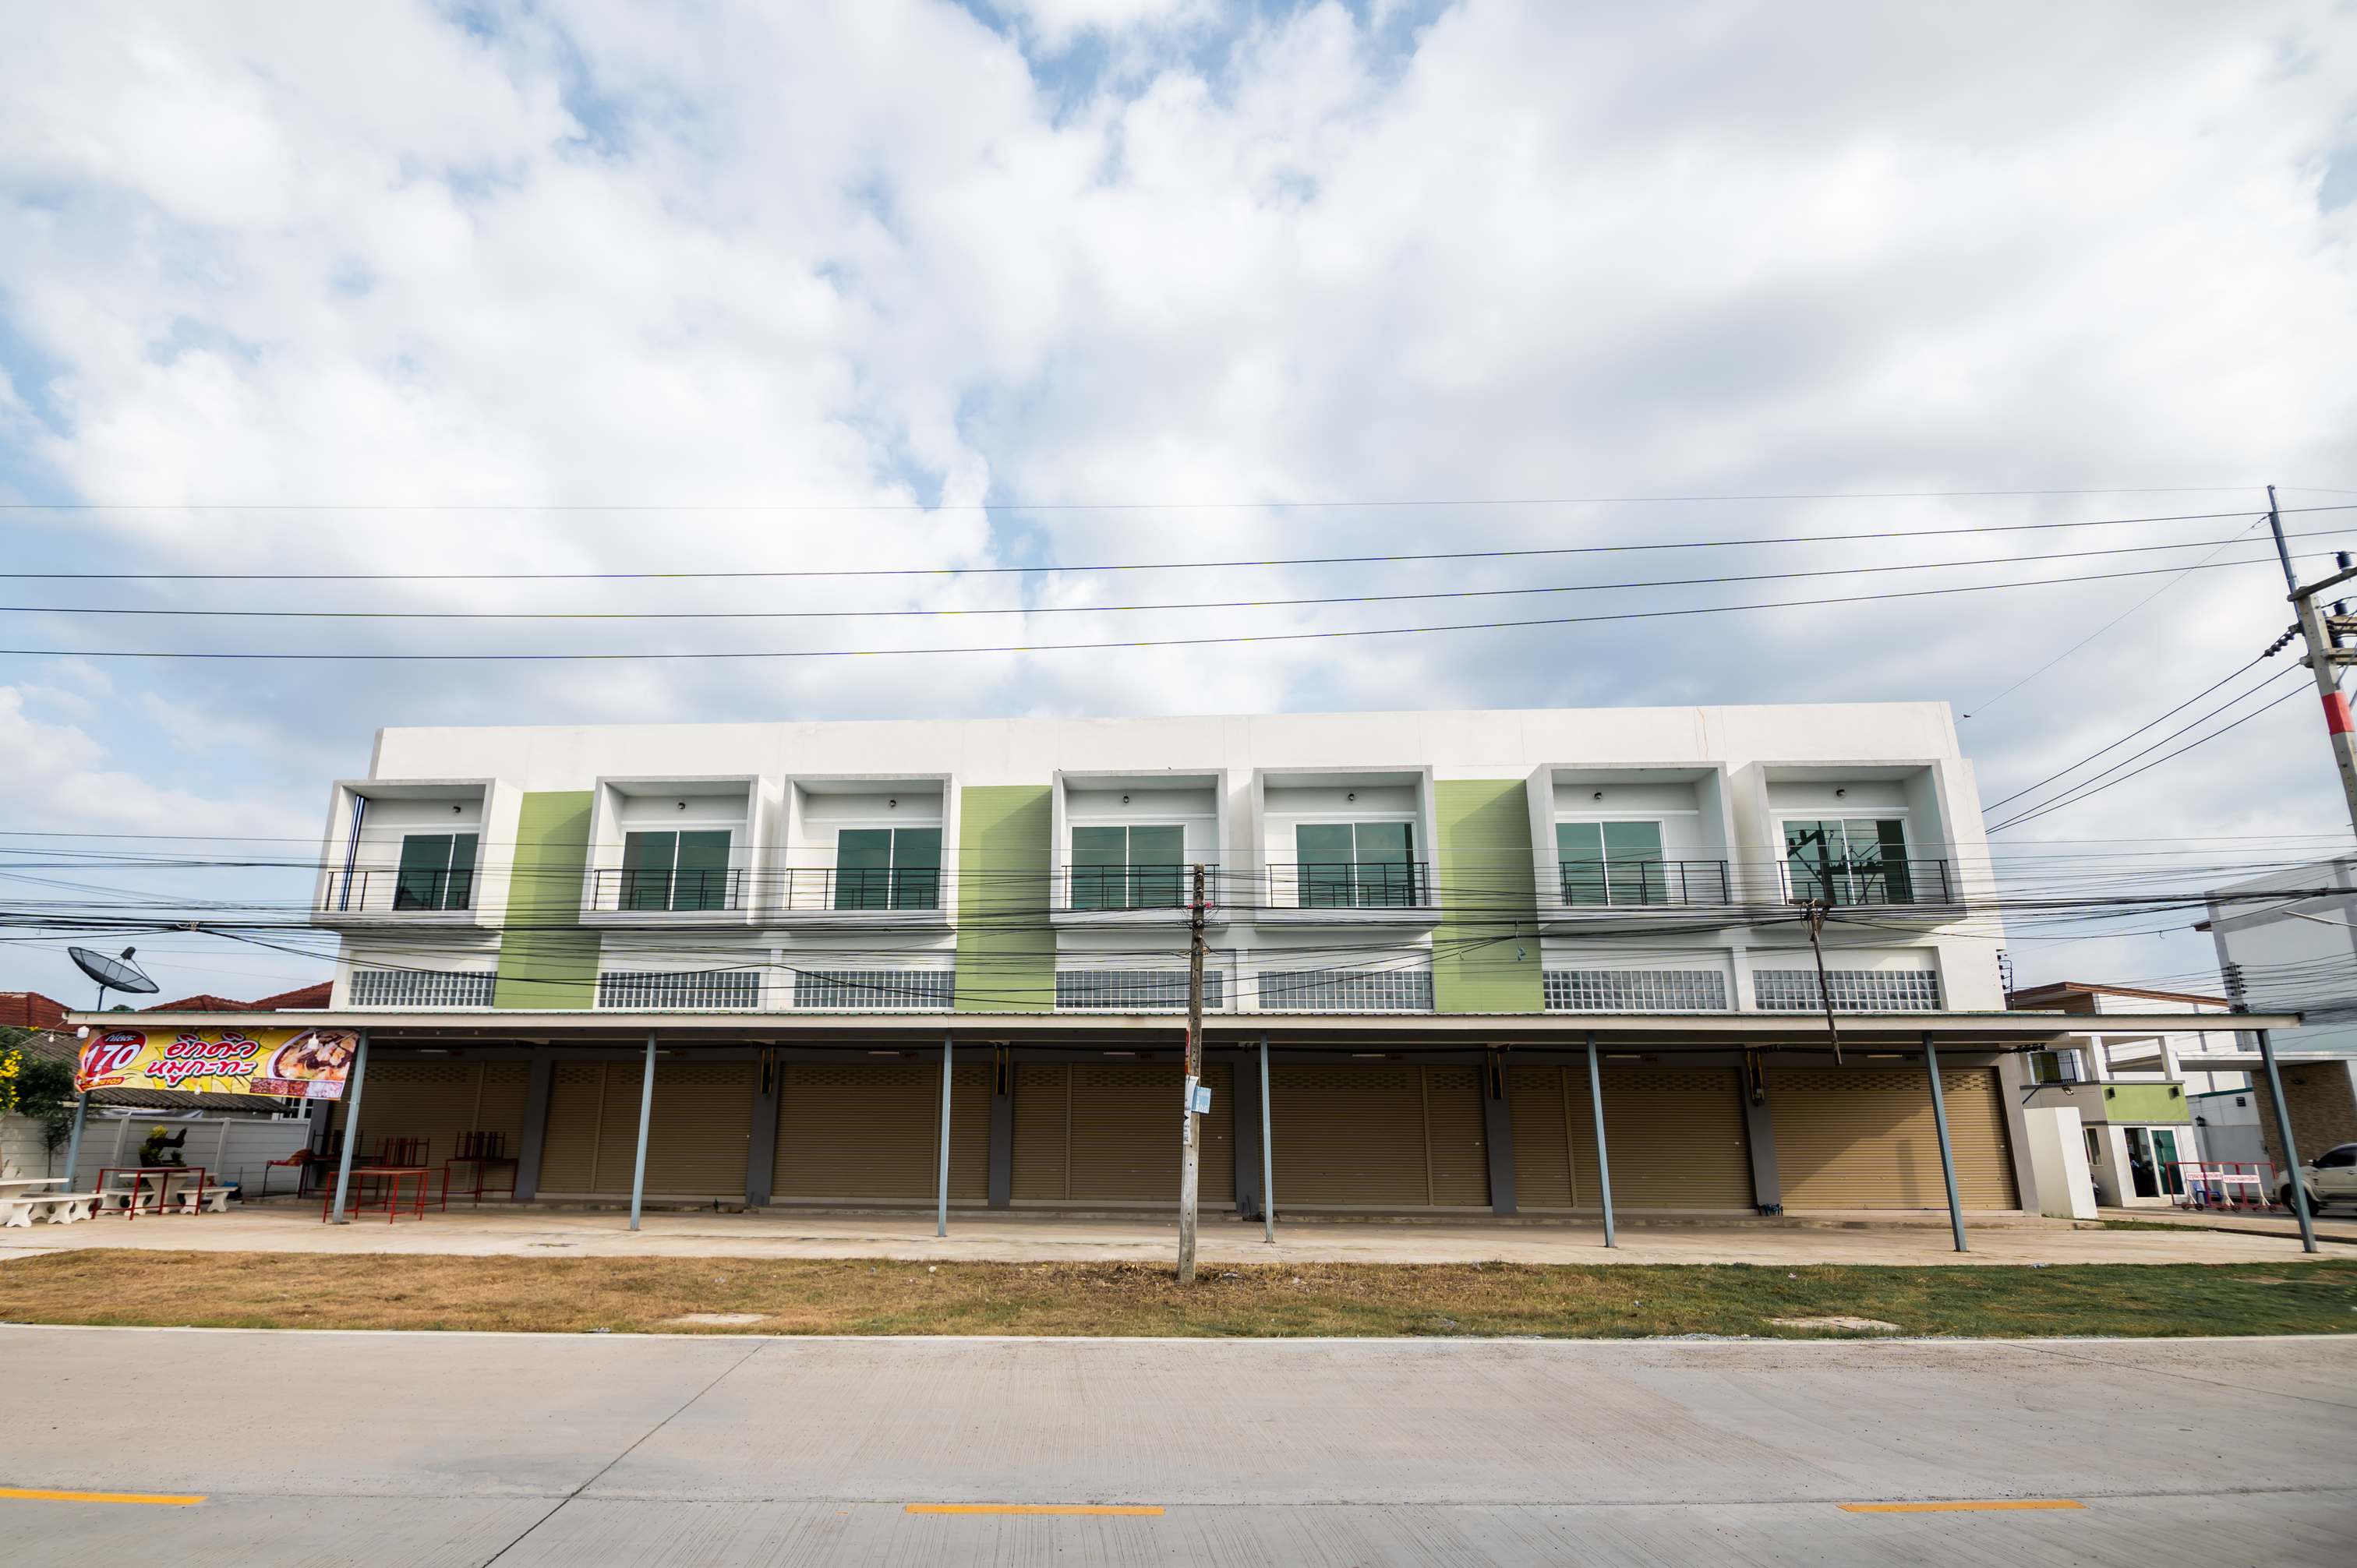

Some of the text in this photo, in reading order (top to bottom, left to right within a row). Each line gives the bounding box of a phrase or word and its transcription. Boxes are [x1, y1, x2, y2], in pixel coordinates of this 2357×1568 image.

[83, 1044, 141, 1072] 170
[145, 1059, 257, 1086] หมูกะทะ
[2187, 1172, 2222, 1181] กรุณาแกบัตร
